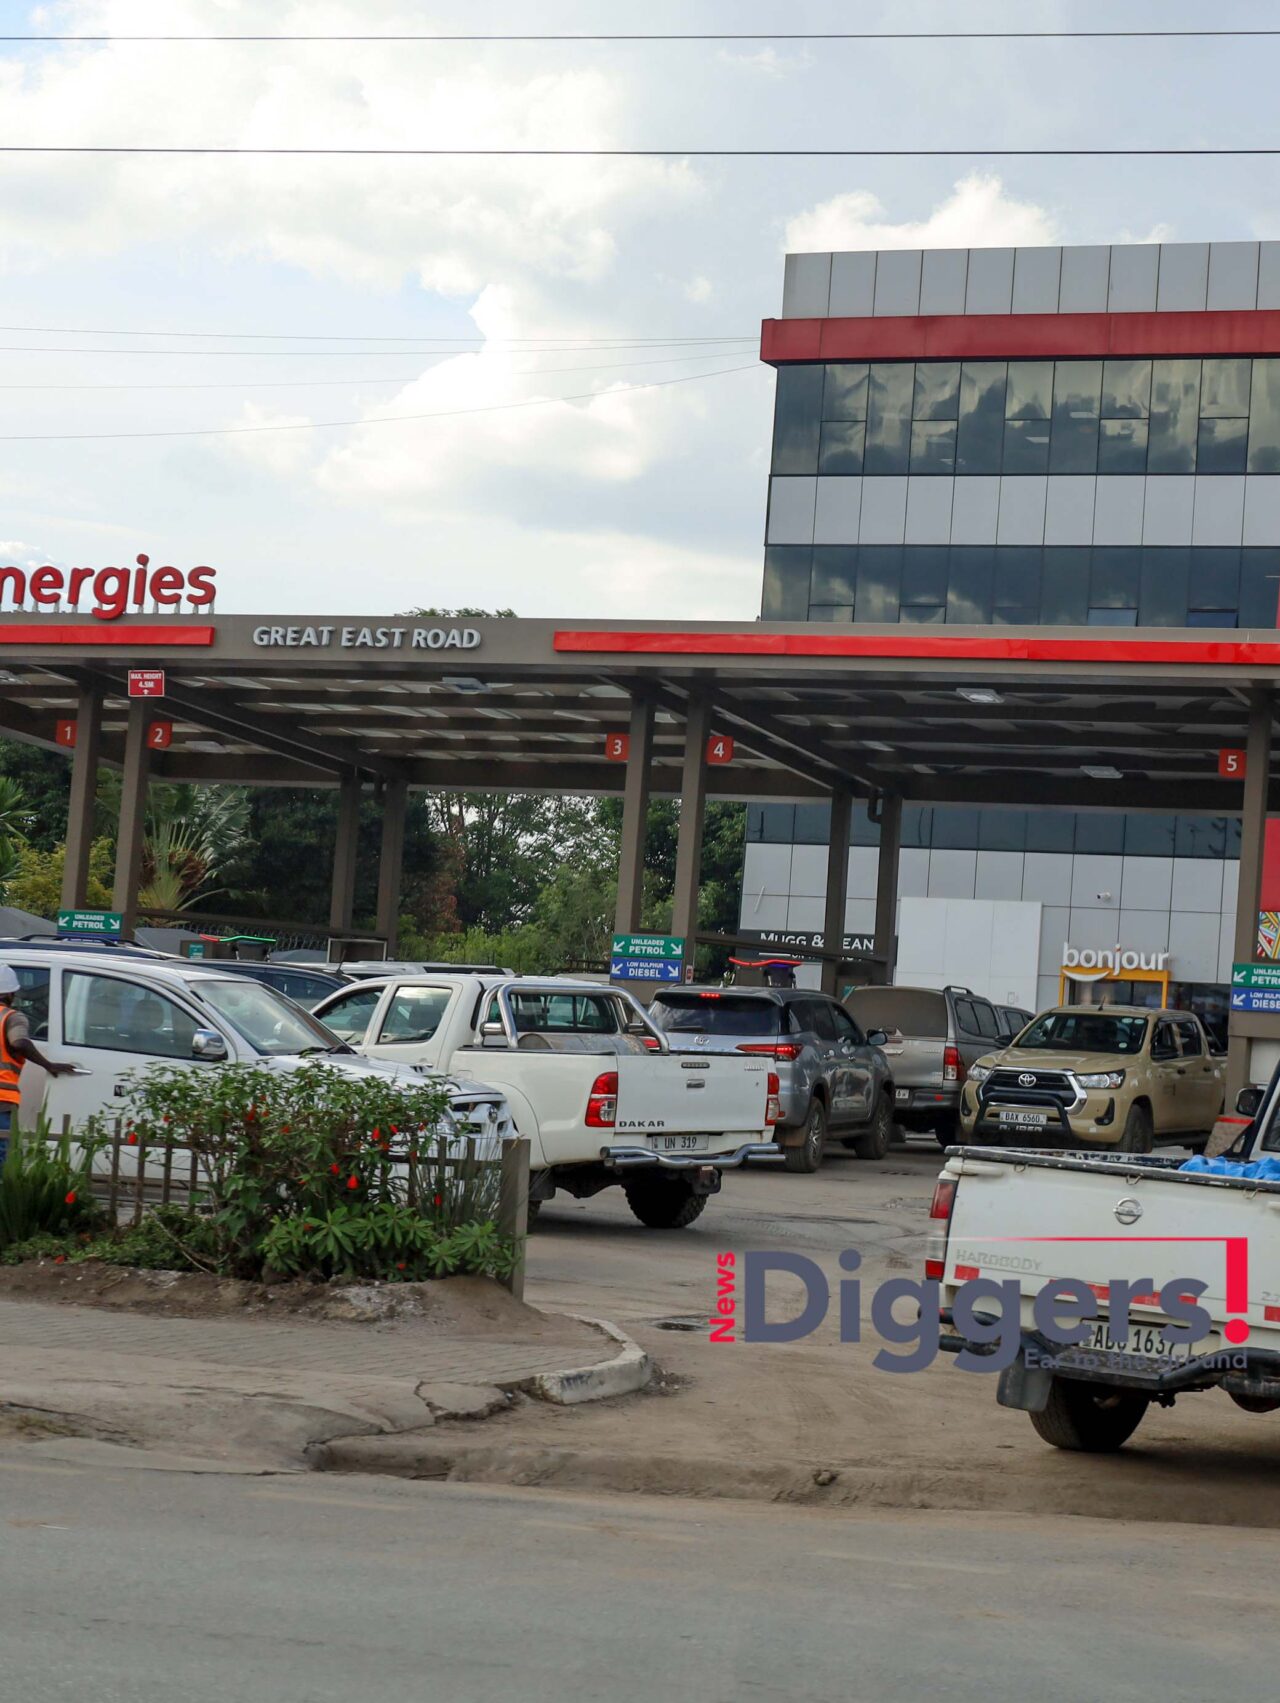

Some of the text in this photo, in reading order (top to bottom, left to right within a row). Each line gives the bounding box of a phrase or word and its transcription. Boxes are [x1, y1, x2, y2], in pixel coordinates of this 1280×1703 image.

[0, 553, 217, 620] nergies
[252, 626, 481, 649] GREAT EAST ROAD
[65, 726, 72, 740] 1
[154, 728, 163, 743] 2
[613, 739, 623, 755] 3
[713, 742, 725, 758] 4
[1226, 755, 1238, 772] 5
[72, 920, 105, 930] PETROL
[629, 945, 666, 955] PETROL
[811, 934, 825, 948] &
[842, 937, 875, 951] EAN
[1062, 941, 1169, 976] bonjour
[628, 968, 662, 978] DIESEL
[619, 1120, 665, 1128] DAKAR
[1022, 1114, 1040, 1123] 6560
[664, 1137, 676, 1149] UN
[681, 1136, 697, 1149] 319
[956, 1248, 1042, 1271] HARDBODY
